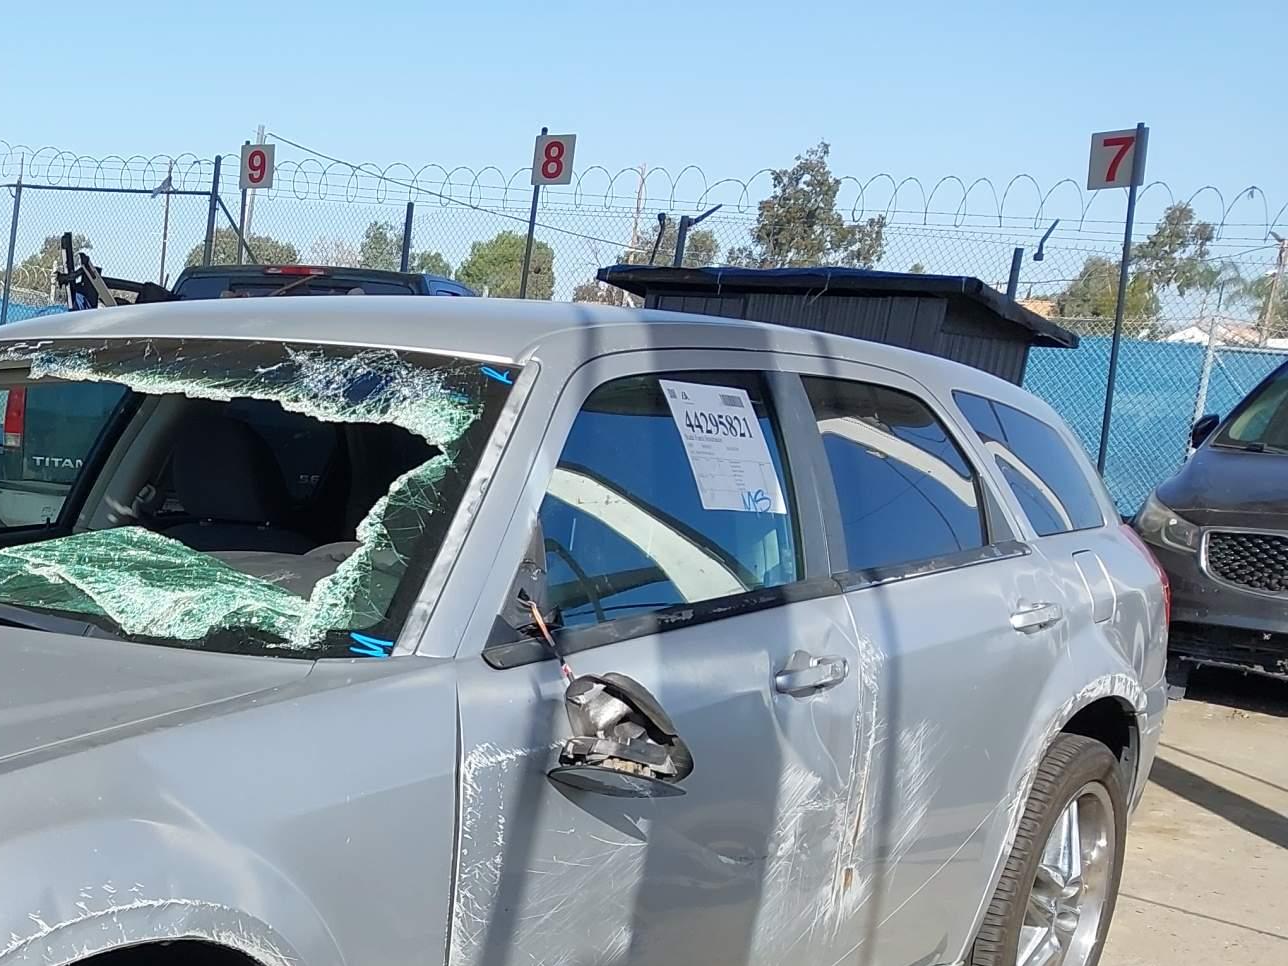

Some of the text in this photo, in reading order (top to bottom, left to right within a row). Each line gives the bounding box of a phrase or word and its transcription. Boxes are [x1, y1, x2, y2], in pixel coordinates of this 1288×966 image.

[249, 151, 265, 183] 9
[542, 141, 564, 179] 8
[1104, 137, 1135, 182] 7
[685, 409, 753, 438] 44295821
